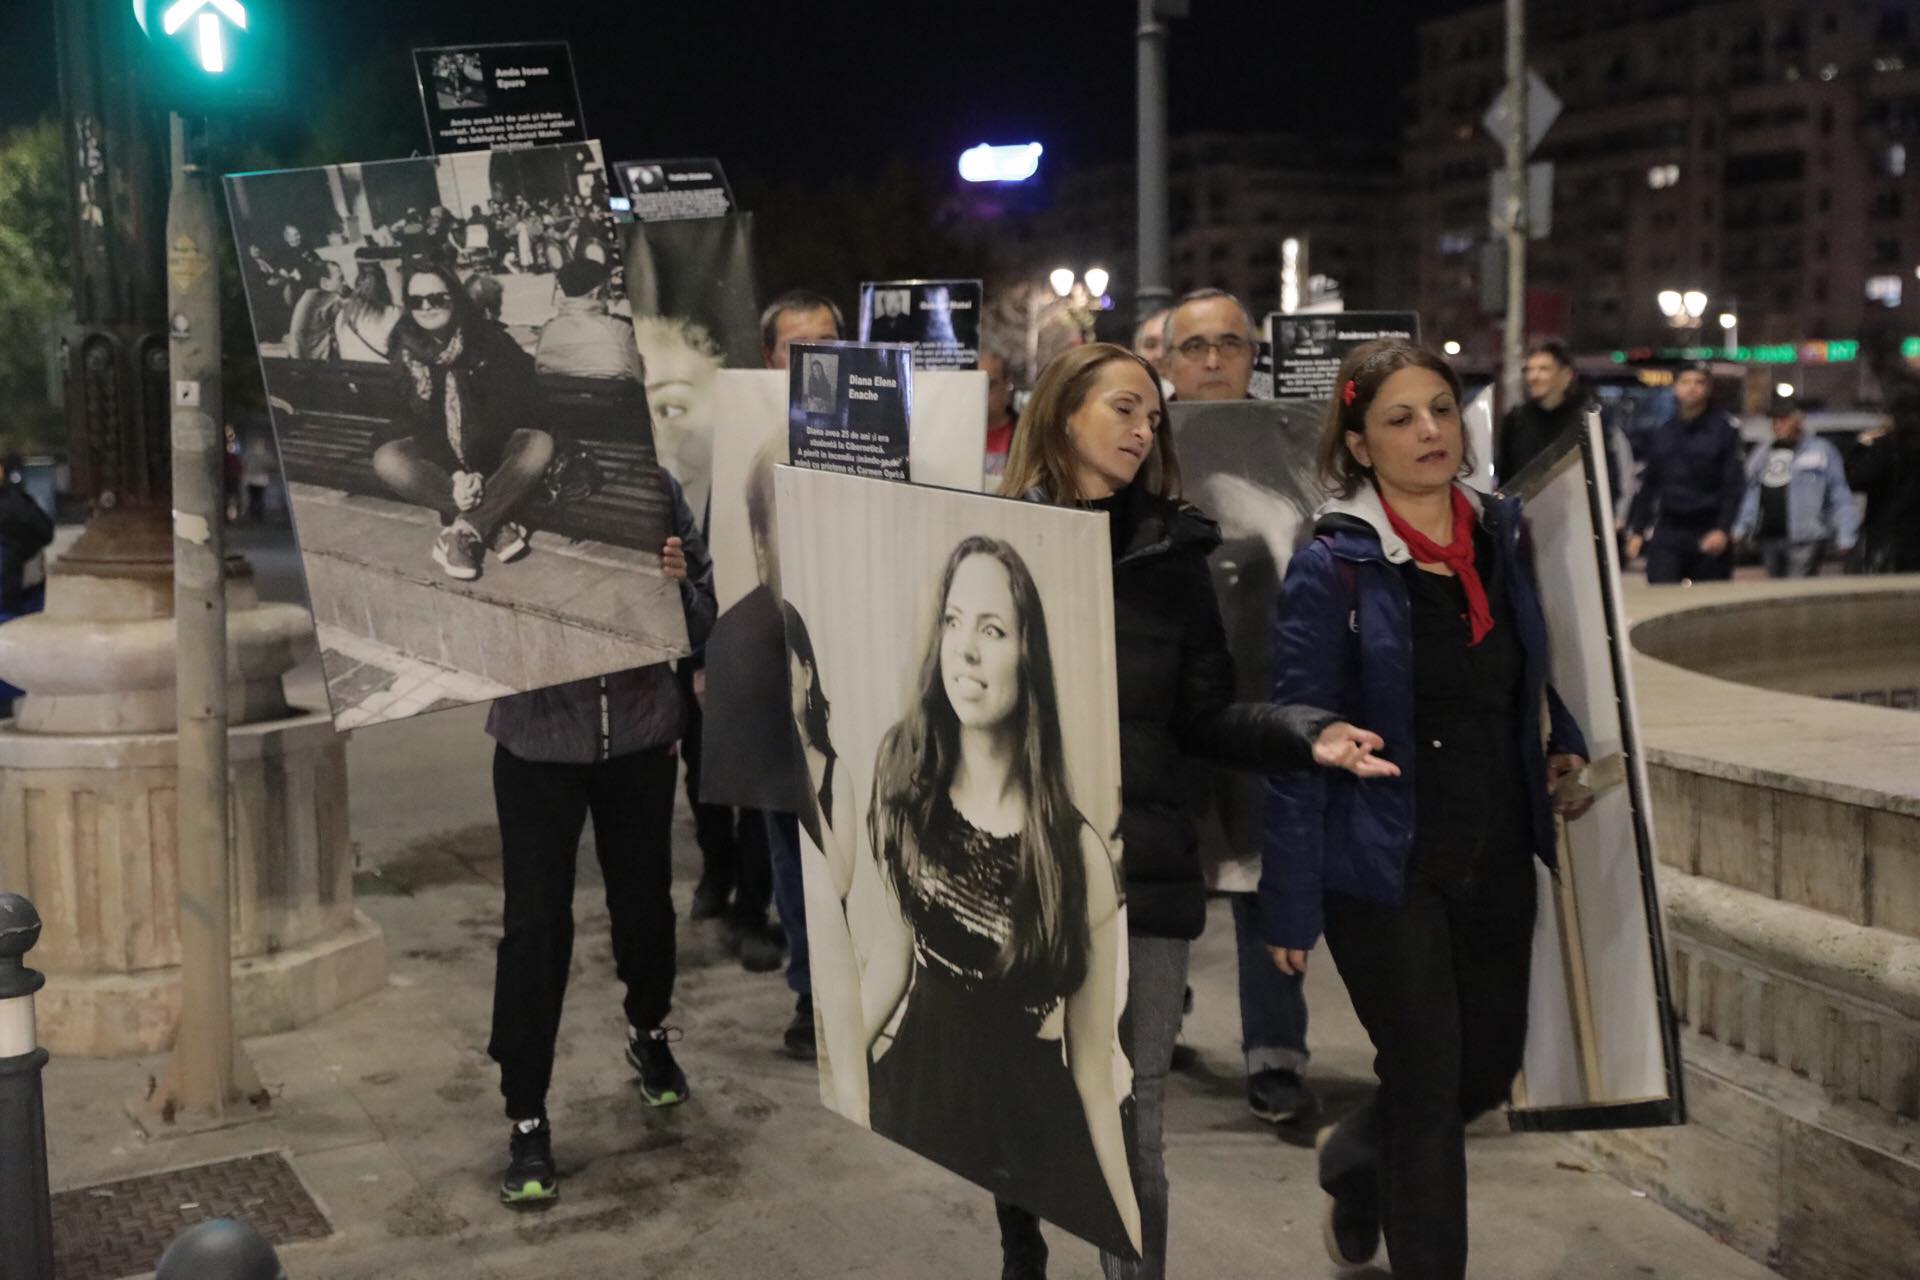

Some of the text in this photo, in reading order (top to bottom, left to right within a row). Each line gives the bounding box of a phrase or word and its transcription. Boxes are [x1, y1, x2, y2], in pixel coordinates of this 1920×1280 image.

[495, 66, 549, 77] Anda Ioana
[496, 79, 526, 90] Epure
[505, 114, 516, 122] de
[850, 375, 897, 387] Diana Elena
[849, 389, 879, 400] Enache
[807, 427, 824, 435] Diana
[826, 430, 840, 438] avea
[851, 431, 859, 439] de
[861, 433, 870, 441] ani
[804, 450, 820, 458] pierit
[829, 451, 855, 460] incendiu
[813, 462, 820, 470] cu
